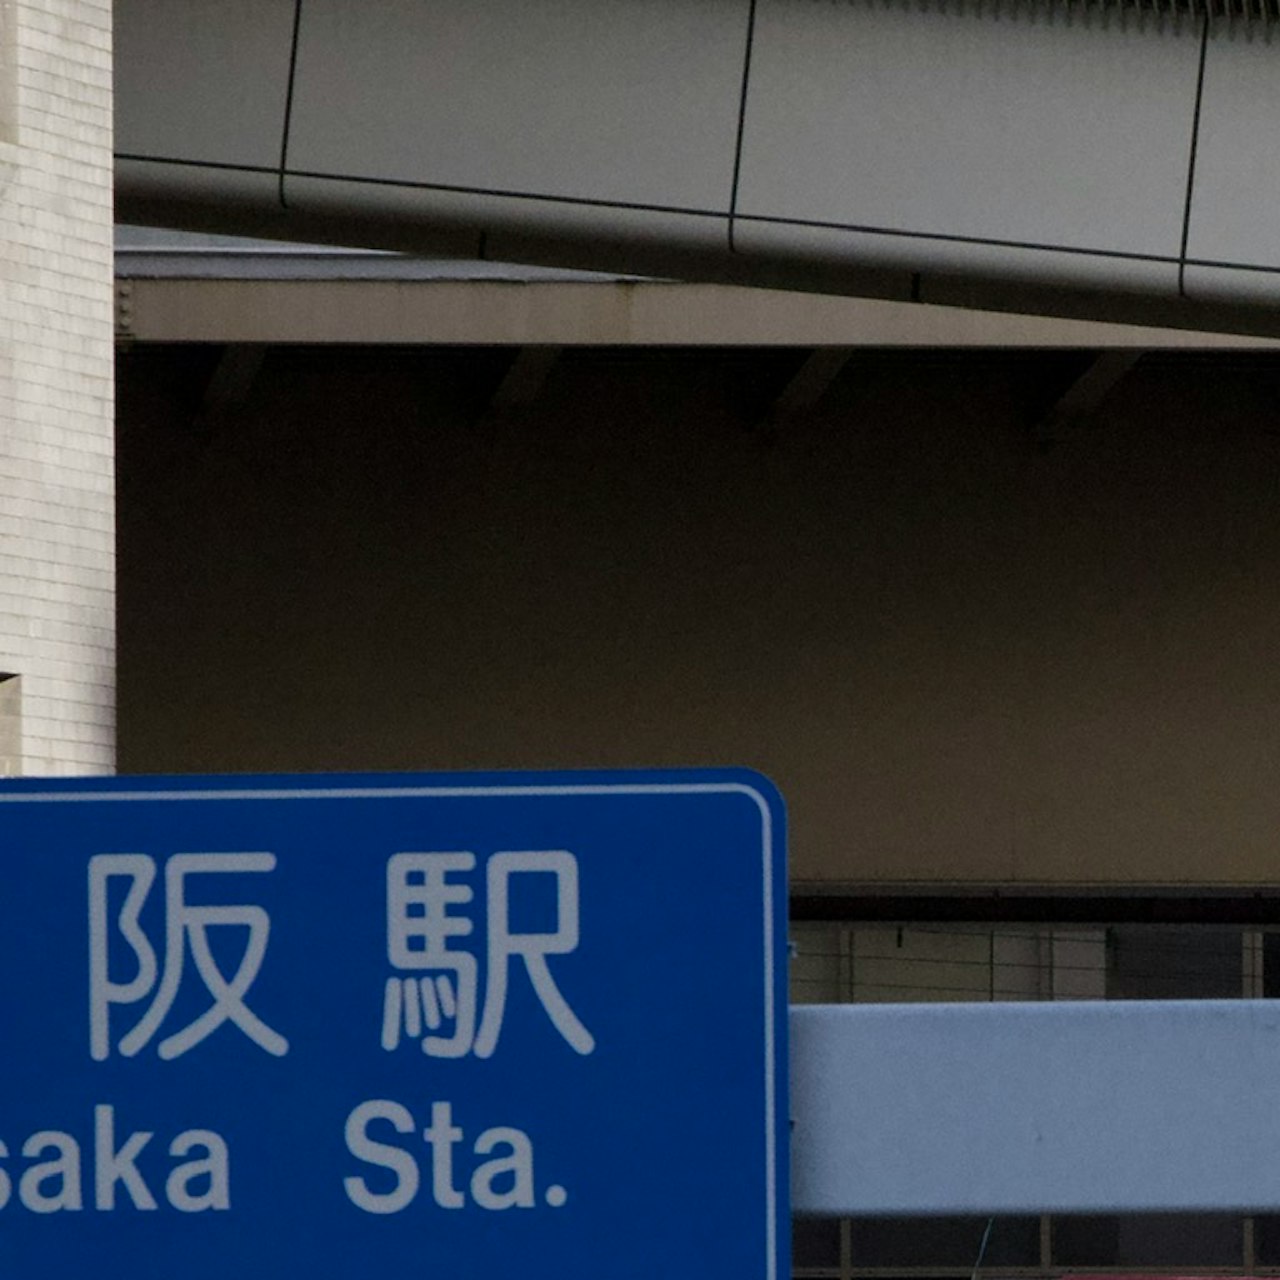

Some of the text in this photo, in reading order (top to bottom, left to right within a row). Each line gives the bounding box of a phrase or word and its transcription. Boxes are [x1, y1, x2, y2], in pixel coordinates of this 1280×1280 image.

[89, 851, 594, 1060] 阪駅
[0, 1100, 566, 1213] aka Sta.
